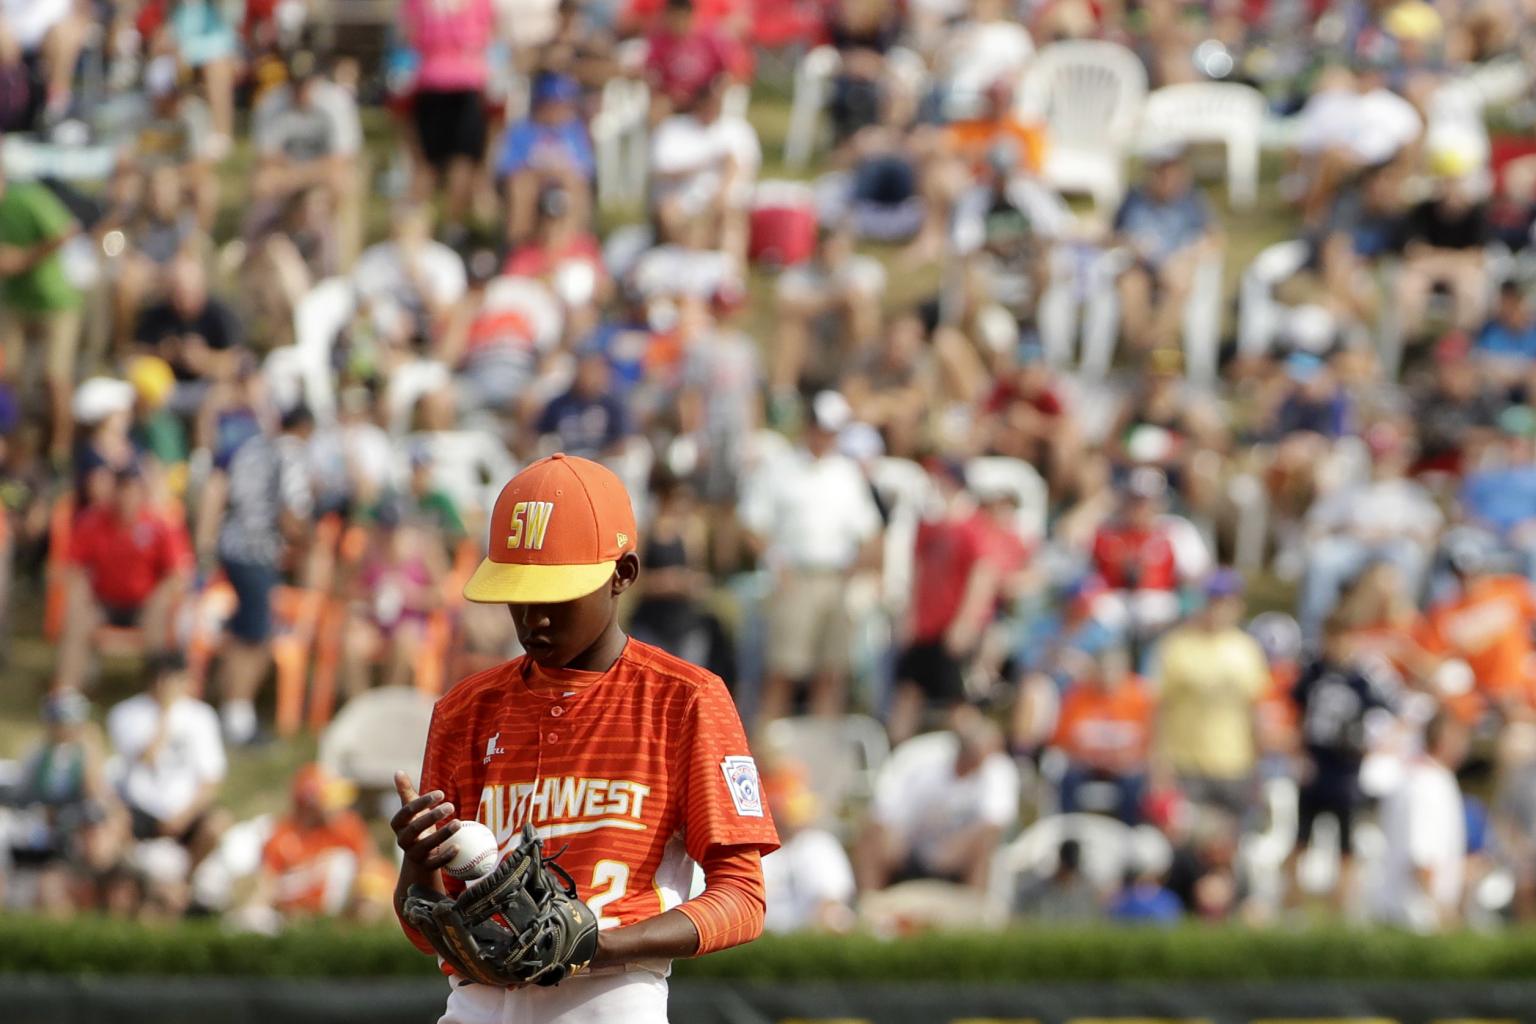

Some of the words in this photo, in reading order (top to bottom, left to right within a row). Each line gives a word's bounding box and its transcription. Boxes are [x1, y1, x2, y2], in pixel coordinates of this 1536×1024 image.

[507, 501, 554, 550] SW
[476, 776, 651, 845] OUTHWEST
[585, 858, 630, 930] 2
